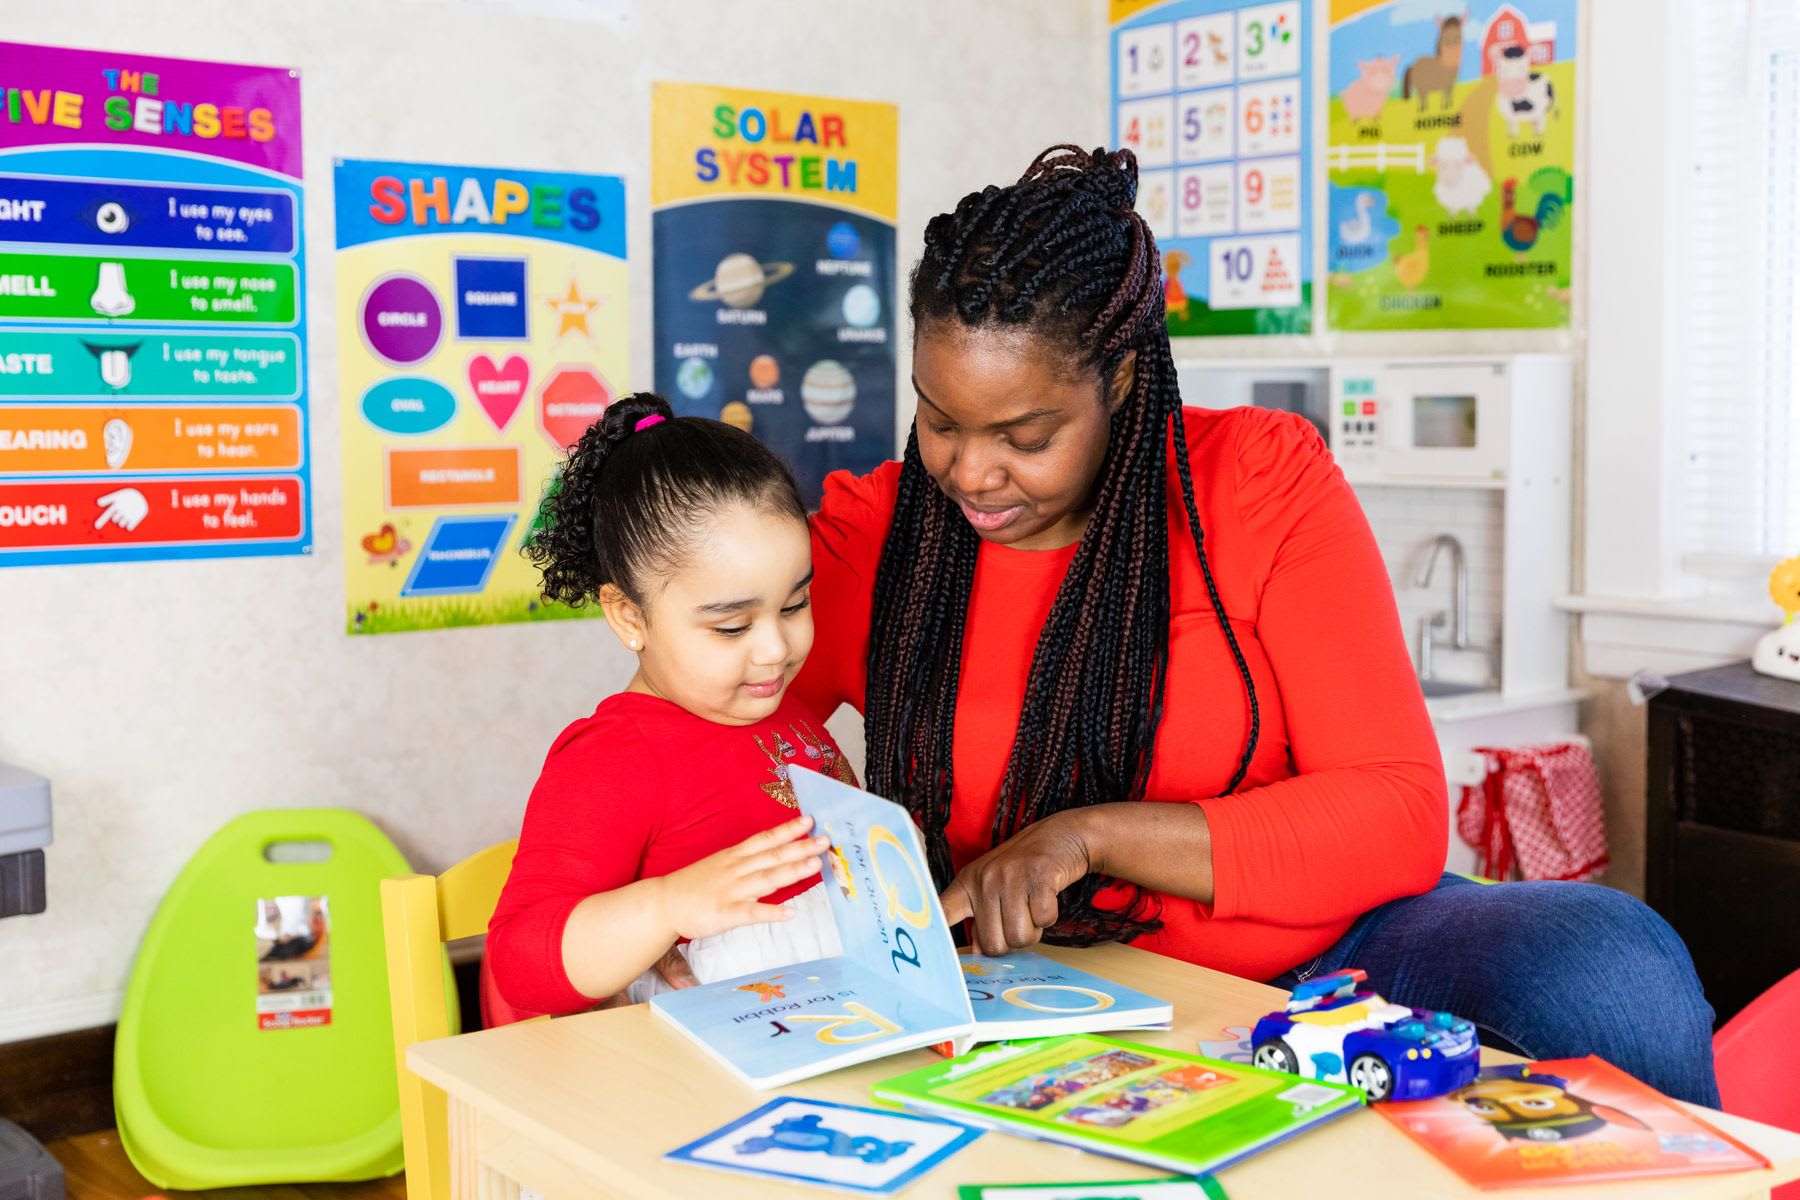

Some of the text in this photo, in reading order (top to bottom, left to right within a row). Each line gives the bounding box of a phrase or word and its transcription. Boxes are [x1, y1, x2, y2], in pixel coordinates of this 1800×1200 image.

[1184, 32, 1201, 67] 2
[1246, 21, 1264, 56] 3
[1128, 45, 1139, 75] 1
[102, 69, 159, 95] THE
[0, 86, 275, 142] IVE SENSES
[712, 104, 847, 148] SOLAR
[1184, 107, 1201, 142] 5
[1245, 98, 1264, 135] 6
[1416, 116, 1460, 130] HORSE
[1125, 116, 1141, 145] 4
[1510, 143, 1541, 157] COW
[695, 147, 858, 193] SYSTEM
[1184, 176, 1201, 210] 8
[1245, 169, 1264, 205] 9
[0, 198, 46, 222] GHT
[168, 197, 273, 227] I use my eyes
[369, 175, 601, 232] SHAPES
[195, 224, 248, 243] to see.
[1439, 221, 1483, 236] SHEEP
[816, 260, 872, 277] NEPTUNE
[1222, 247, 1253, 282] 10
[1486, 262, 1556, 277] ROOSTER
[170, 269, 277, 296] I use my nose
[190, 294, 208, 312] to
[465, 290, 517, 307] SQUARE
[377, 311, 428, 328] CIRCLE
[716, 309, 767, 325] SATURN
[163, 342, 286, 368] I use my tongue
[673, 342, 719, 358] EARTH
[193, 369, 211, 384] to
[478, 380, 521, 395] HEART
[391, 398, 425, 413] OVAL
[0, 428, 87, 450] EARING
[175, 417, 279, 442] I use my ears
[804, 426, 855, 442] JUPITER
[197, 444, 215, 458] to
[171, 487, 287, 511] I use my hands
[0, 504, 67, 527] OUCH
[202, 513, 220, 528] to
[868, 824, 931, 930] Q
[853, 845, 866, 868] for
[864, 877, 889, 944] Queen
[1019, 975, 1047, 983] for
[807, 994, 835, 1005] for
[1001, 984, 1116, 1013] O
[733, 1003, 802, 1024] Rabbit
[770, 1002, 904, 1045] R r
